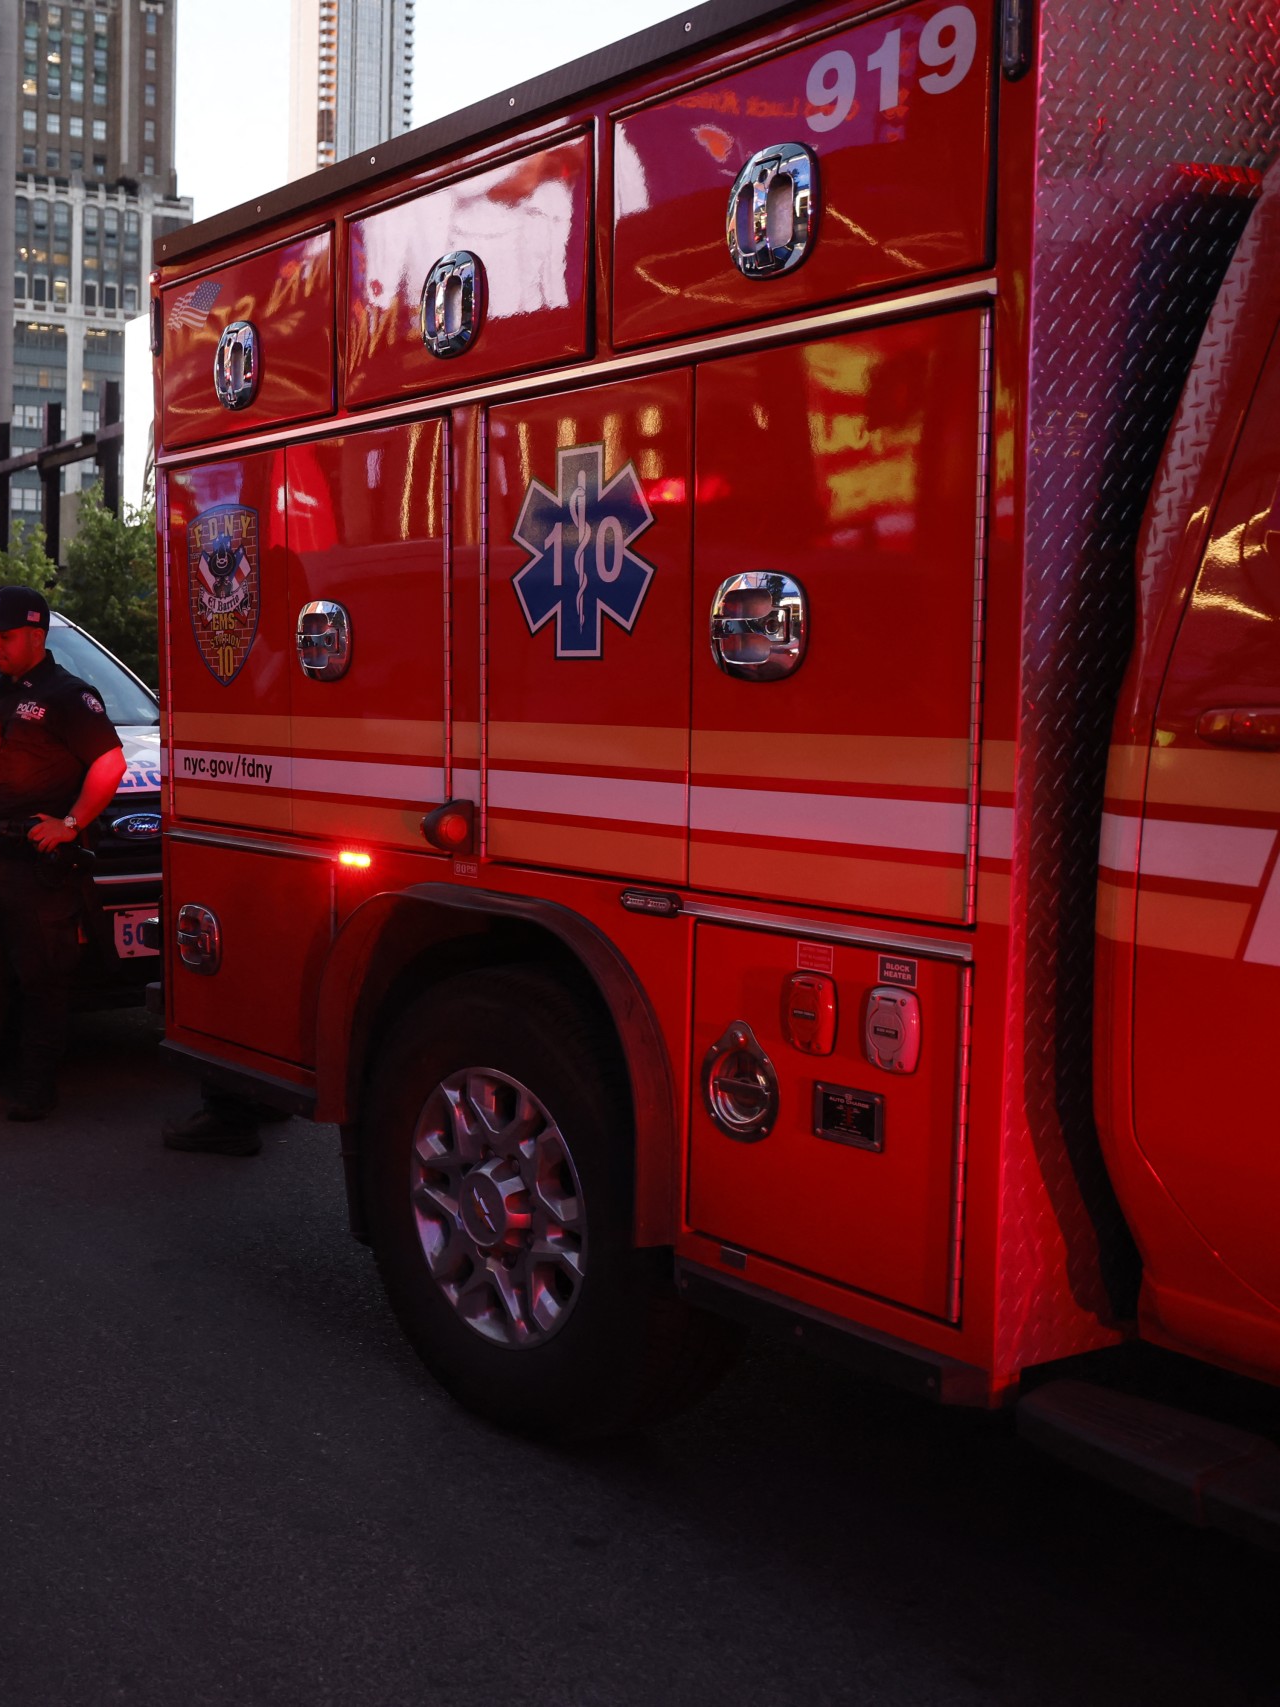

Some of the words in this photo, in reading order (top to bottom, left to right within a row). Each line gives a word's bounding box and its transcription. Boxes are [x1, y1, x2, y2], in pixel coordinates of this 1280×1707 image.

[806, 5, 977, 133] 919
[193, 514, 251, 548] FDNY
[212, 612, 235, 631] EMS
[210, 633, 240, 649] STATION
[217, 645, 234, 677] 10
[16, 702, 46, 718] POLICE
[183, 754, 273, 784] nyc.gov/fdny
[127, 817, 160, 833] Ford
[883, 970, 912, 981] HEATER
[885, 962, 910, 973] BLOCK
[828, 1096, 845, 1104] AUTO
